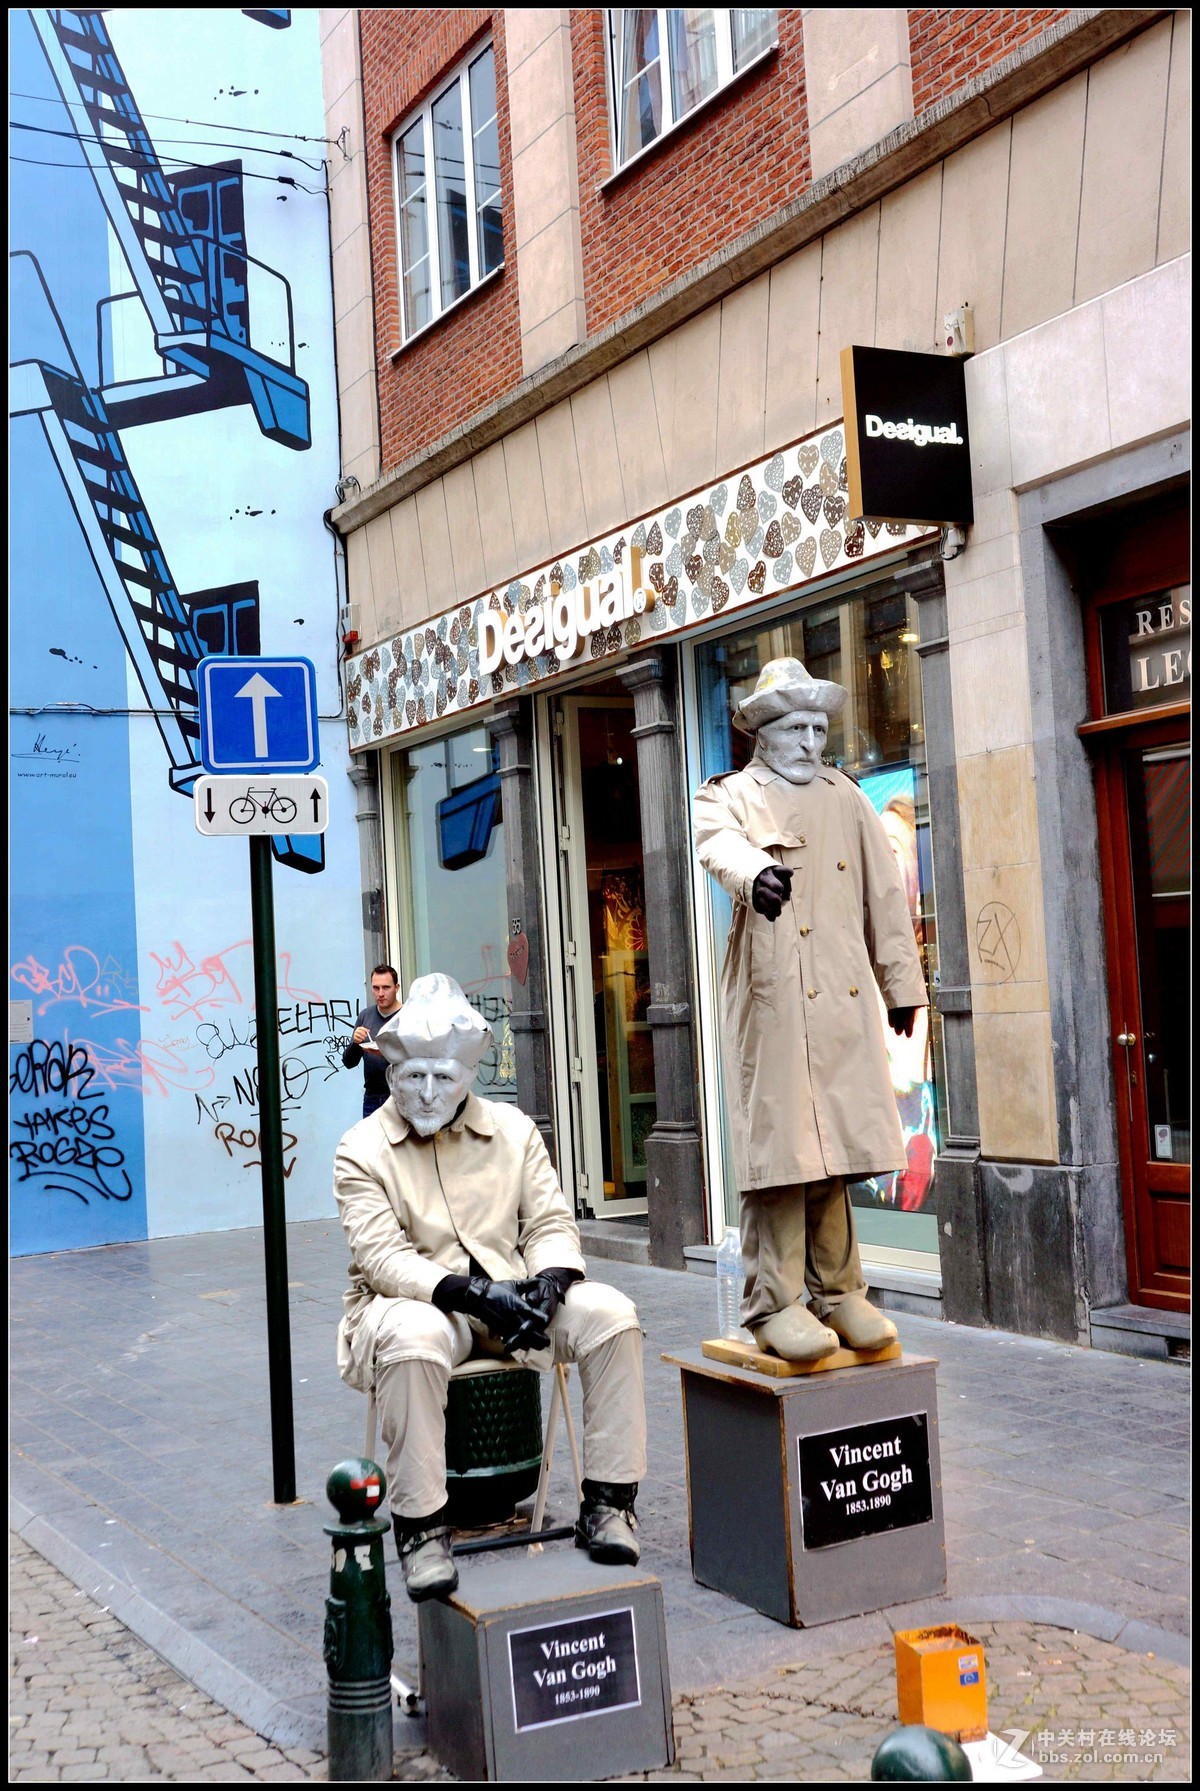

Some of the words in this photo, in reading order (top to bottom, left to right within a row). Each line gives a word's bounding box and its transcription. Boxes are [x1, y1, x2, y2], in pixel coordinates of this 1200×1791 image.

[1136, 599, 1191, 637] RES
[1137, 650, 1191, 692] LE
[512, 917, 521, 934] 35
[829, 1435, 902, 1468] Vincent
[820, 1479, 858, 1502] Van
[862, 1464, 914, 1492] Gogh
[540, 1631, 606, 1660] Vincent
[533, 1668, 567, 1688] Van
[571, 1655, 617, 1680] Gogh
[555, 1685, 601, 1706] 1853-1890
